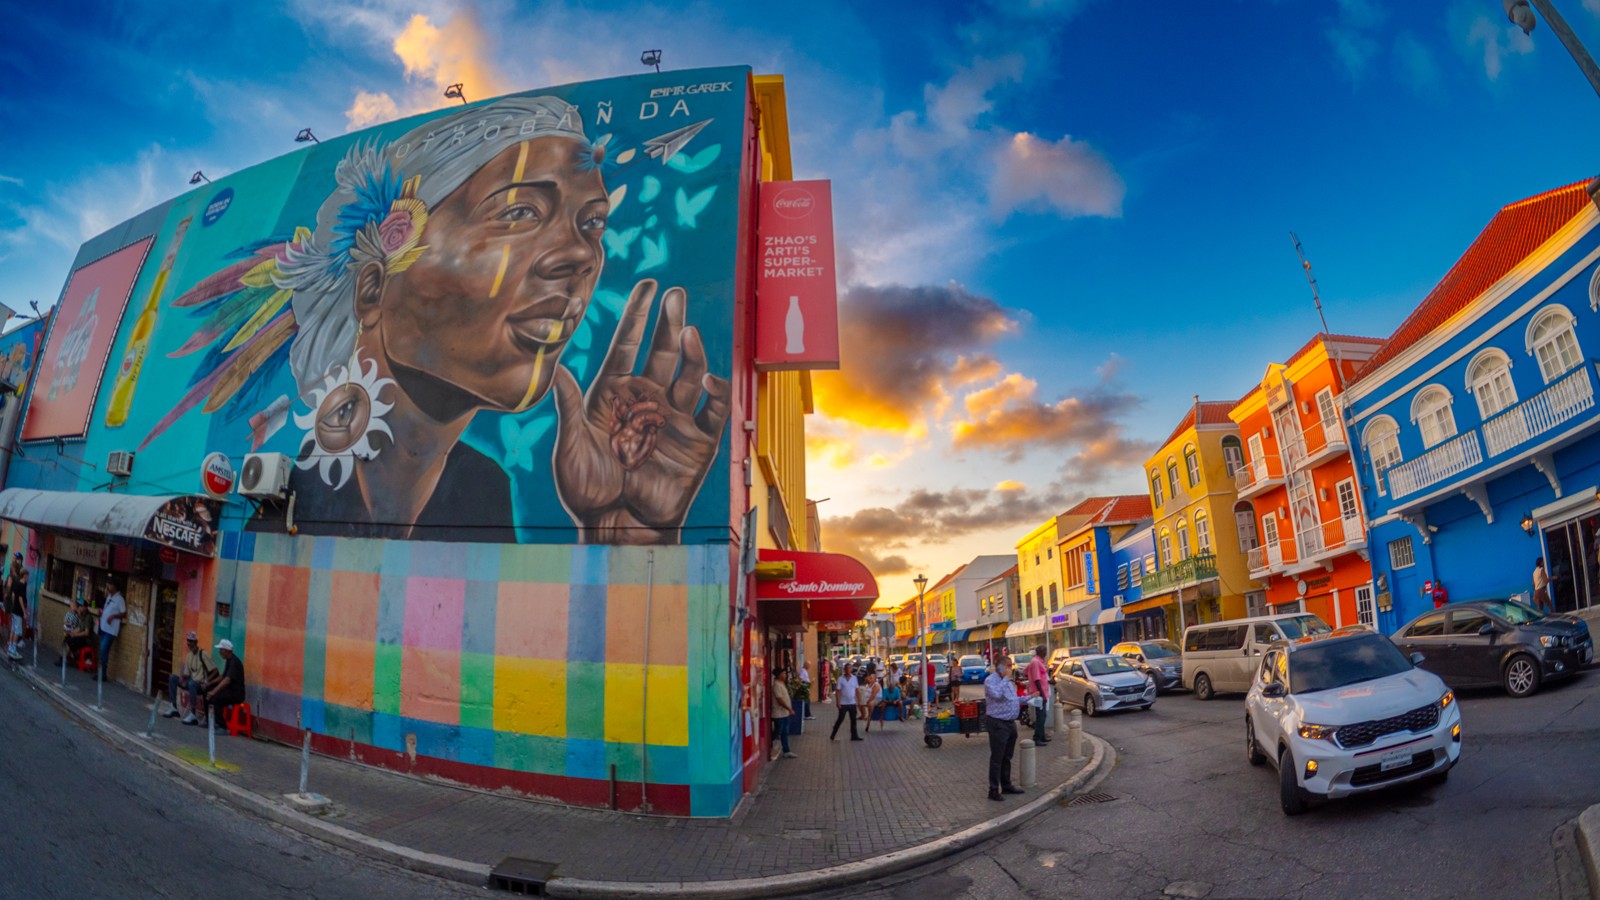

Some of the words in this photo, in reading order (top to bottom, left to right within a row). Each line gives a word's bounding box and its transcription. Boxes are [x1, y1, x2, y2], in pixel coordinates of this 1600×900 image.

[764, 235, 817, 246] ZHAO'S
[764, 246, 810, 256] ARTI'S
[764, 256, 816, 267] SUPER-
[764, 267, 825, 278] MARKET
[209, 463, 232, 481] AMSTEL
[787, 581, 819, 594] Santo
[818, 580, 865, 596] Domingo
